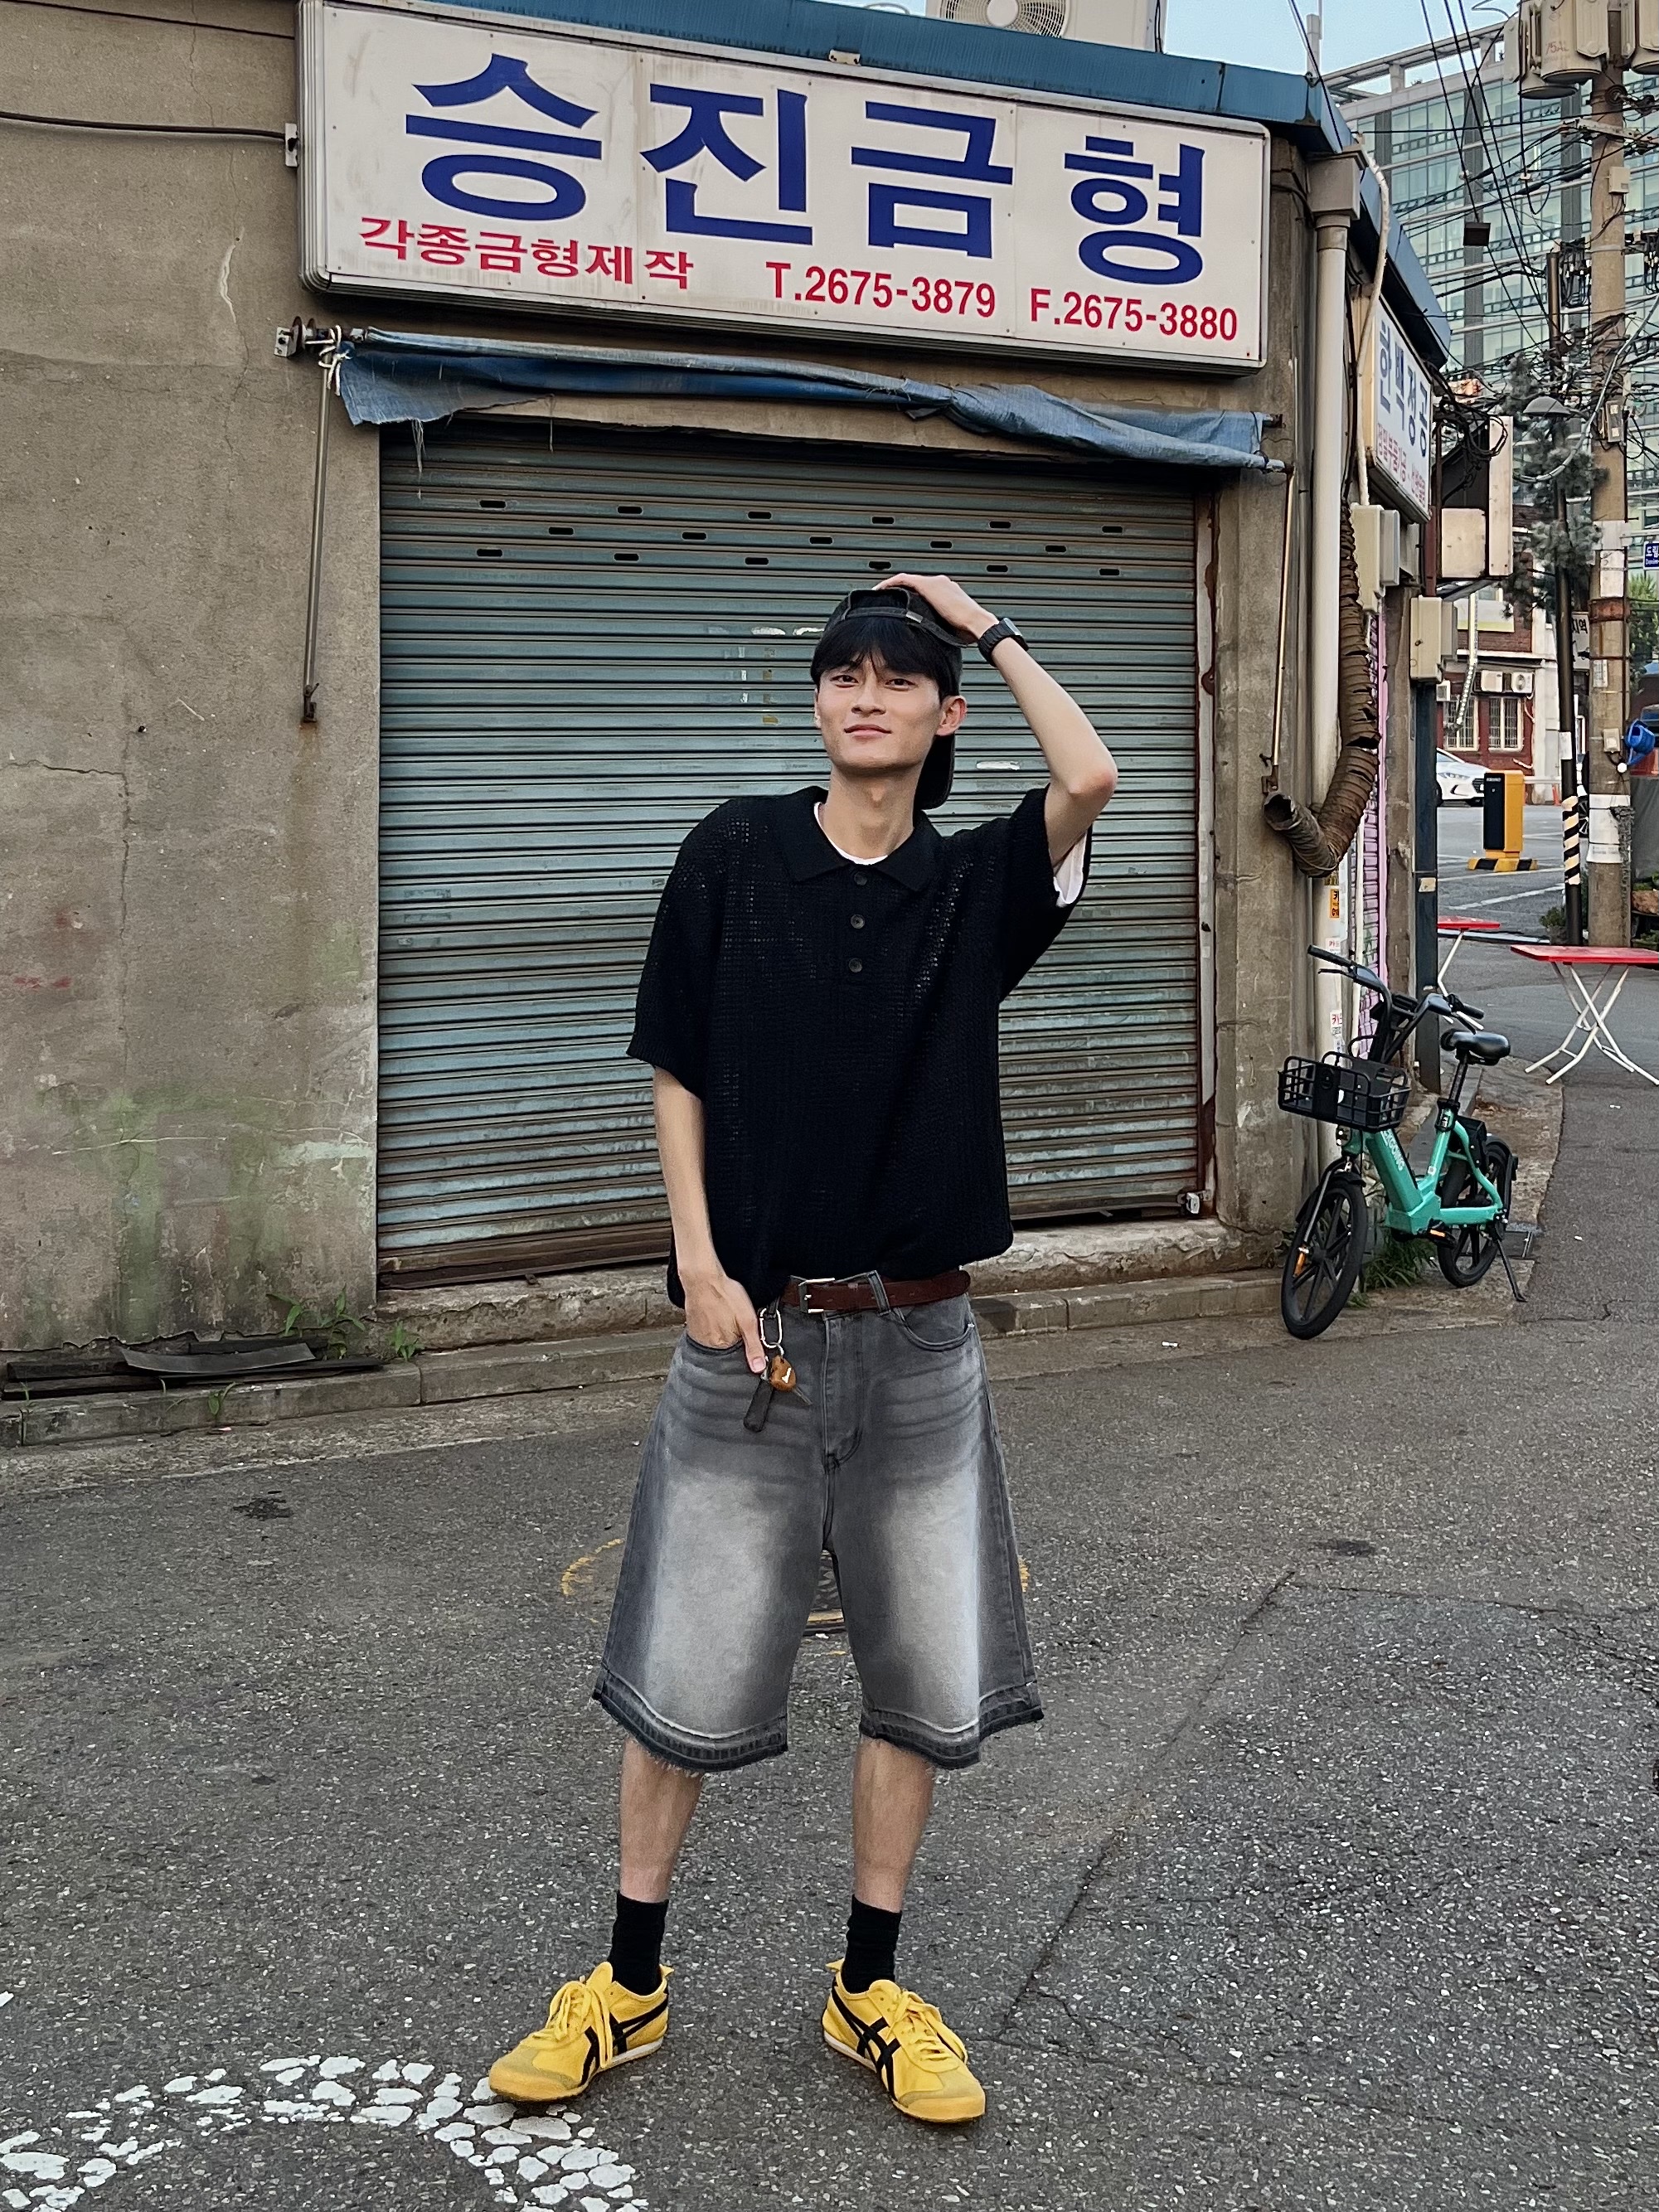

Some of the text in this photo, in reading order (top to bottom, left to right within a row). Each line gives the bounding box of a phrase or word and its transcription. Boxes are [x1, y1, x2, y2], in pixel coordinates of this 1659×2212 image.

[406, 53, 1205, 284] 승진금형
[359, 217, 694, 289] 각종금형제작
[766, 262, 1238, 342] T.2675-3879 F.2675-3880
[1380, 320, 1427, 458] 한백정공
[1646, 546, 1659, 558] 도림
